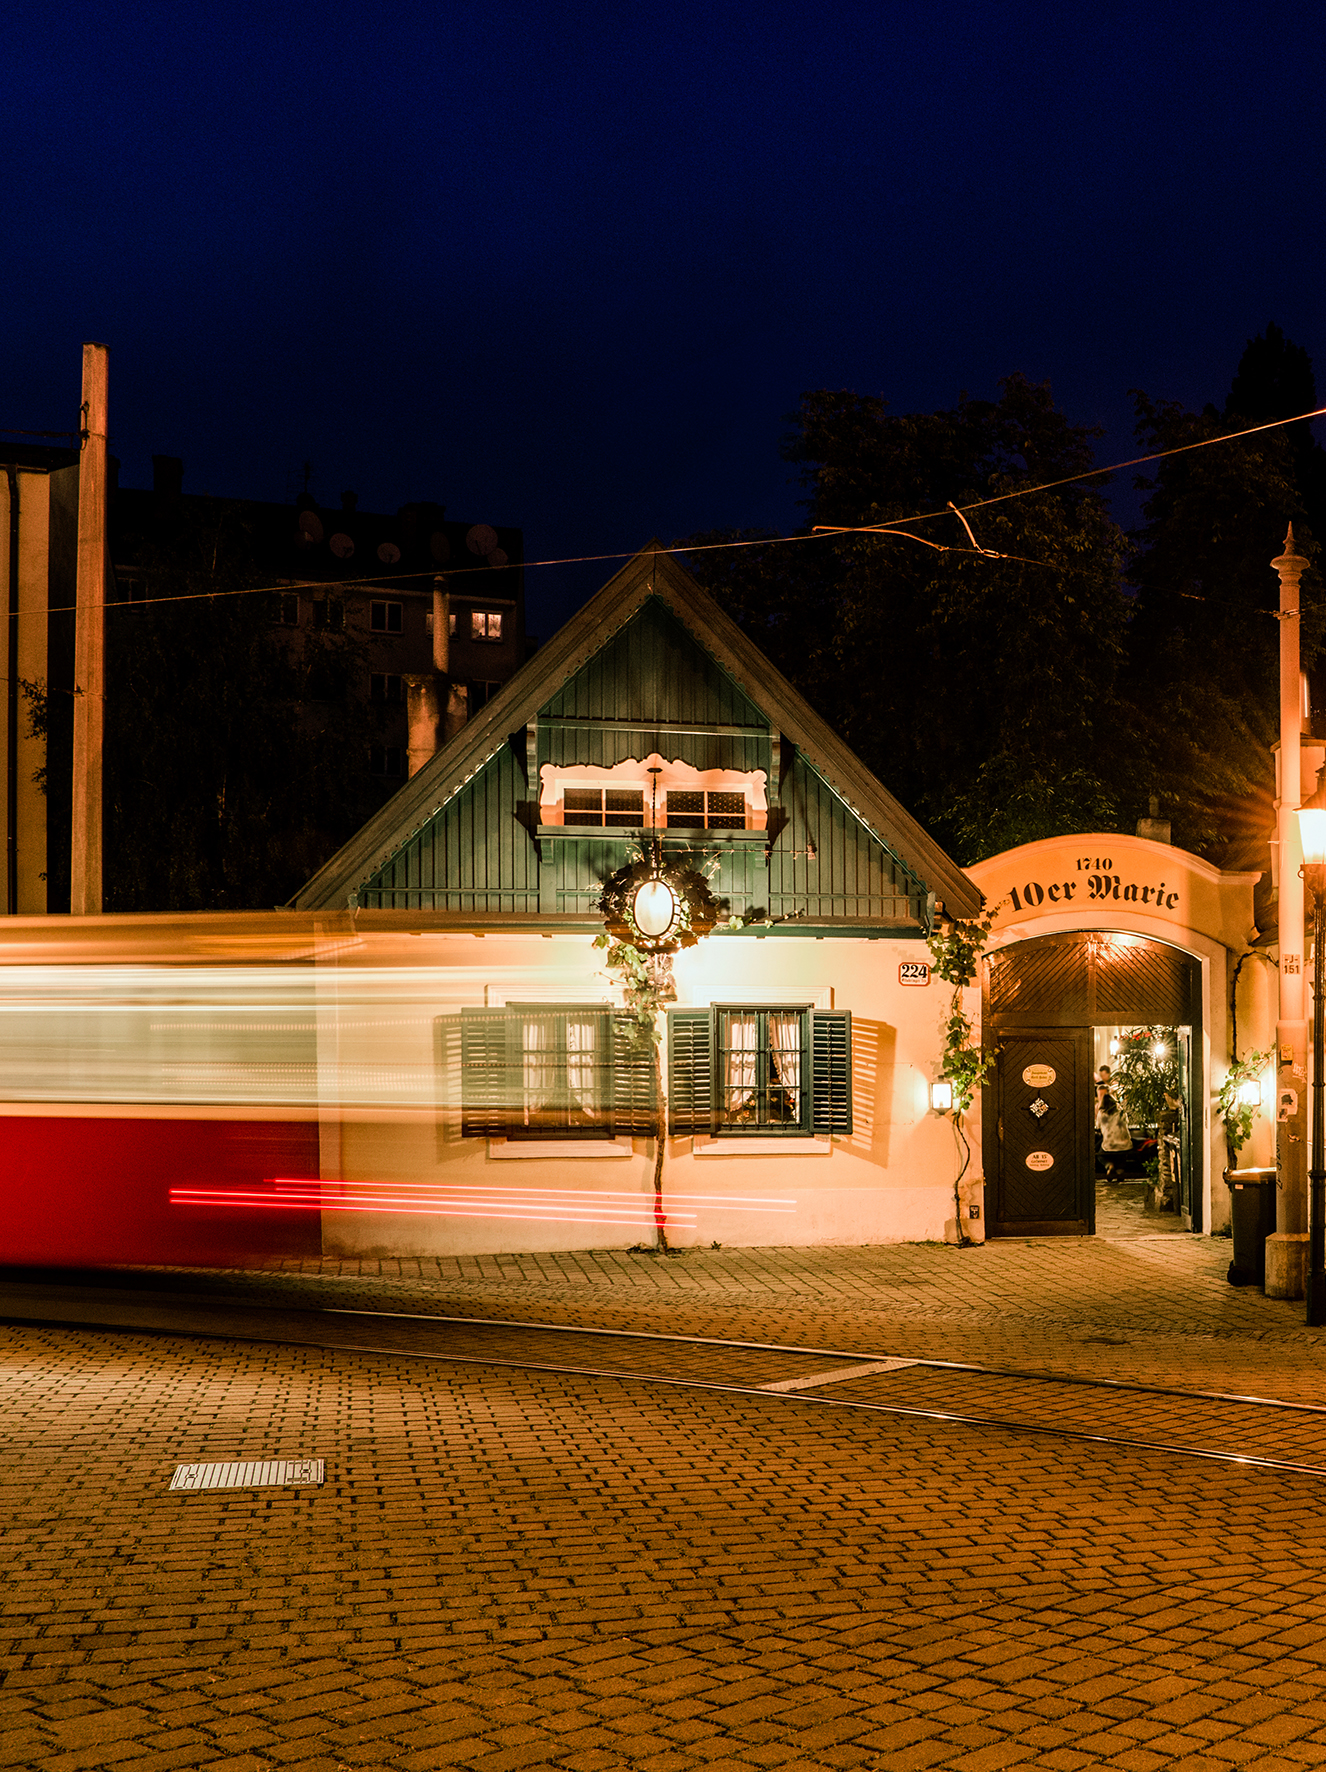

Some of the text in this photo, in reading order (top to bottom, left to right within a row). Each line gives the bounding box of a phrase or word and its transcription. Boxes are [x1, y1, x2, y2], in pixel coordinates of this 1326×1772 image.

[1076, 857, 1113, 871] 1740
[1006, 874, 1180, 912] 10er Marie
[901, 964, 927, 978] 224
[1284, 964, 1299, 974] 151
